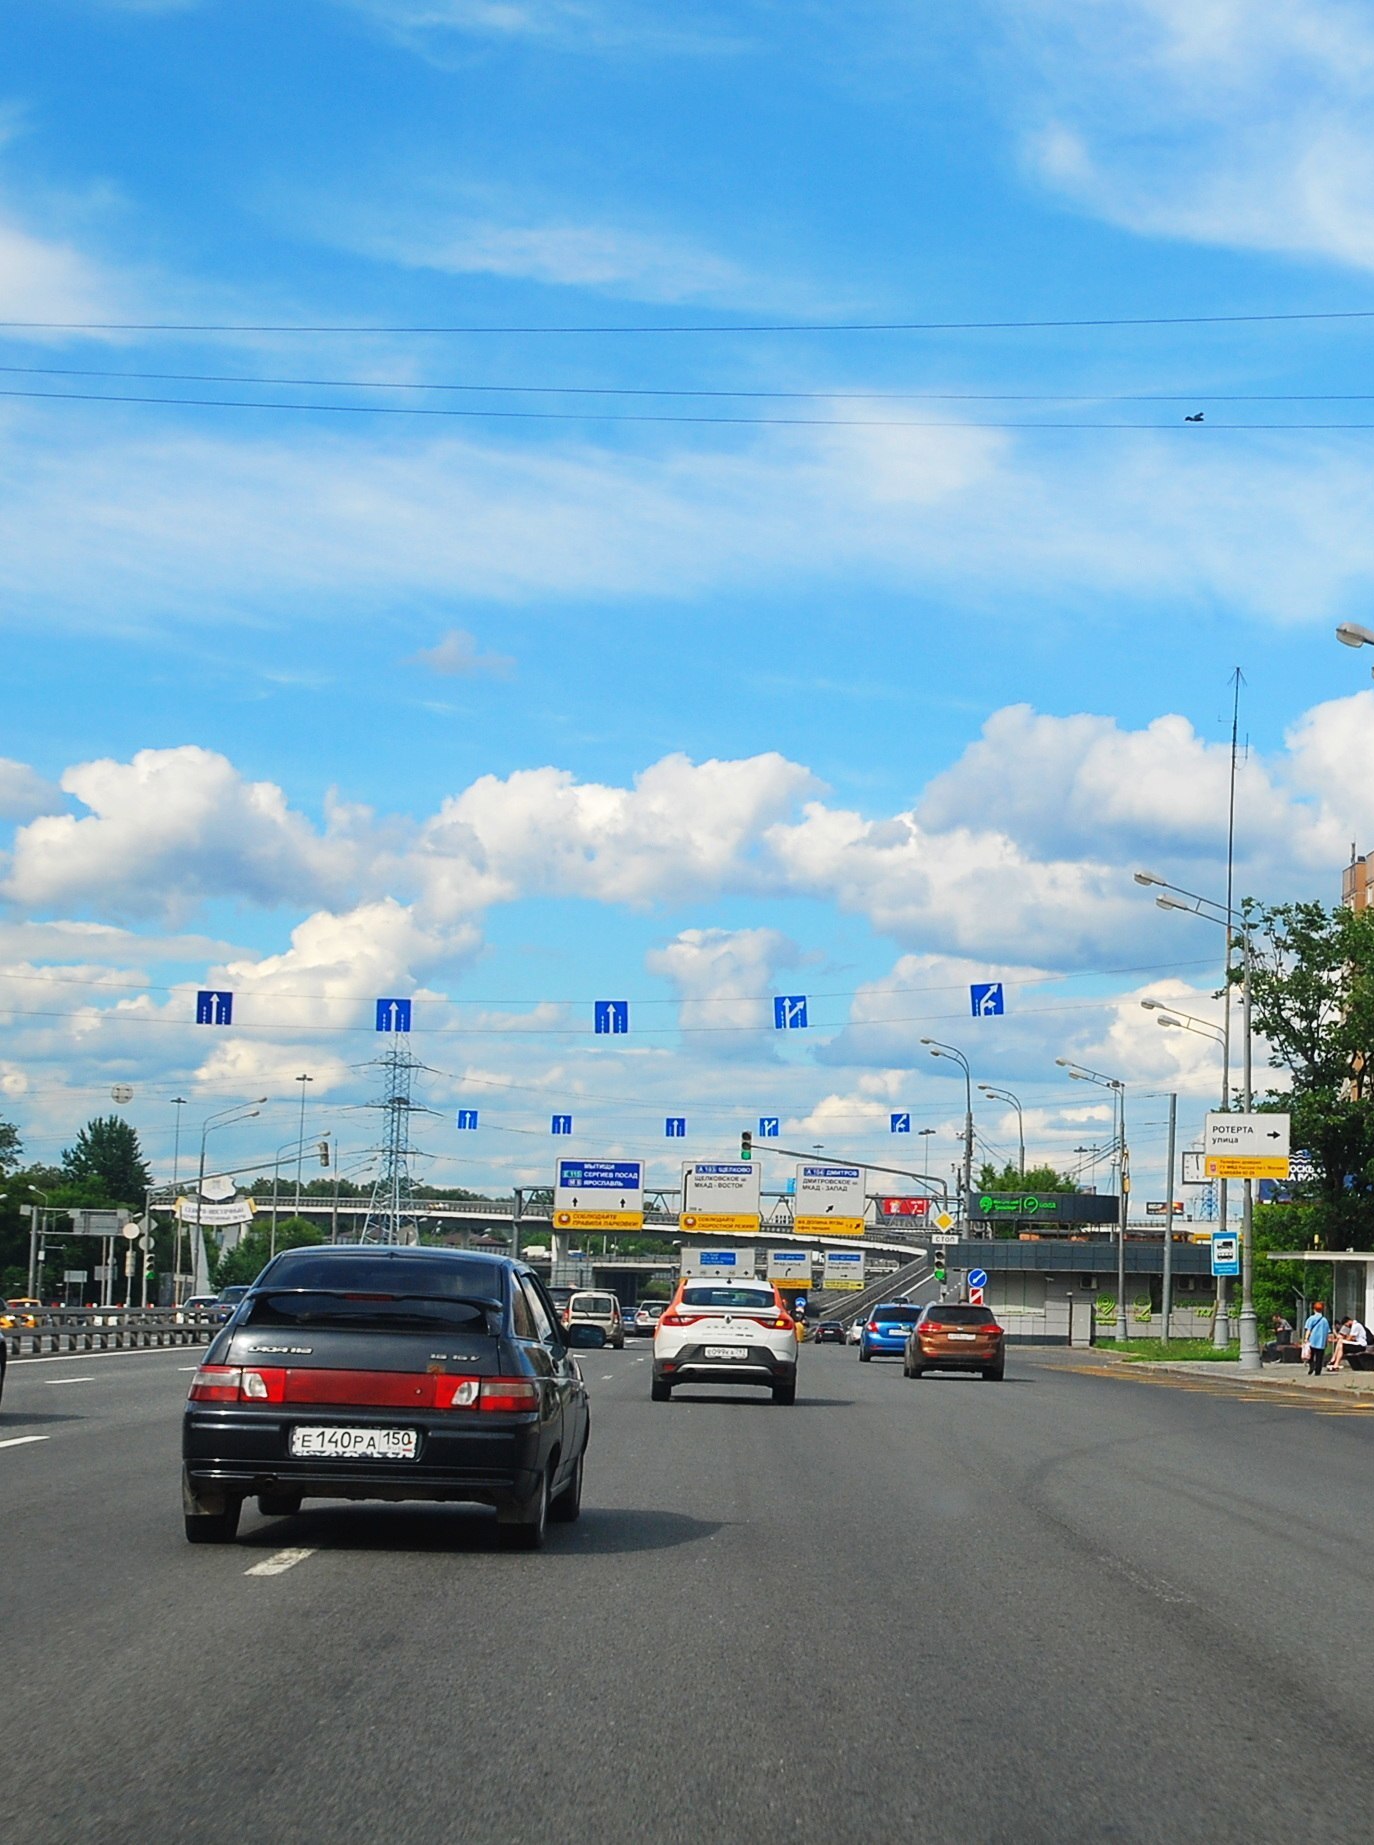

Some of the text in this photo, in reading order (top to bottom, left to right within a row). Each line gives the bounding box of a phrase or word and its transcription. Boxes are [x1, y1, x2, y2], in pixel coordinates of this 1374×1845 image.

[1212, 1126, 1254, 1134] РОТЕРТА
[1212, 1137, 1239, 1145] улица
[382, 1431, 412, 1446] 150
